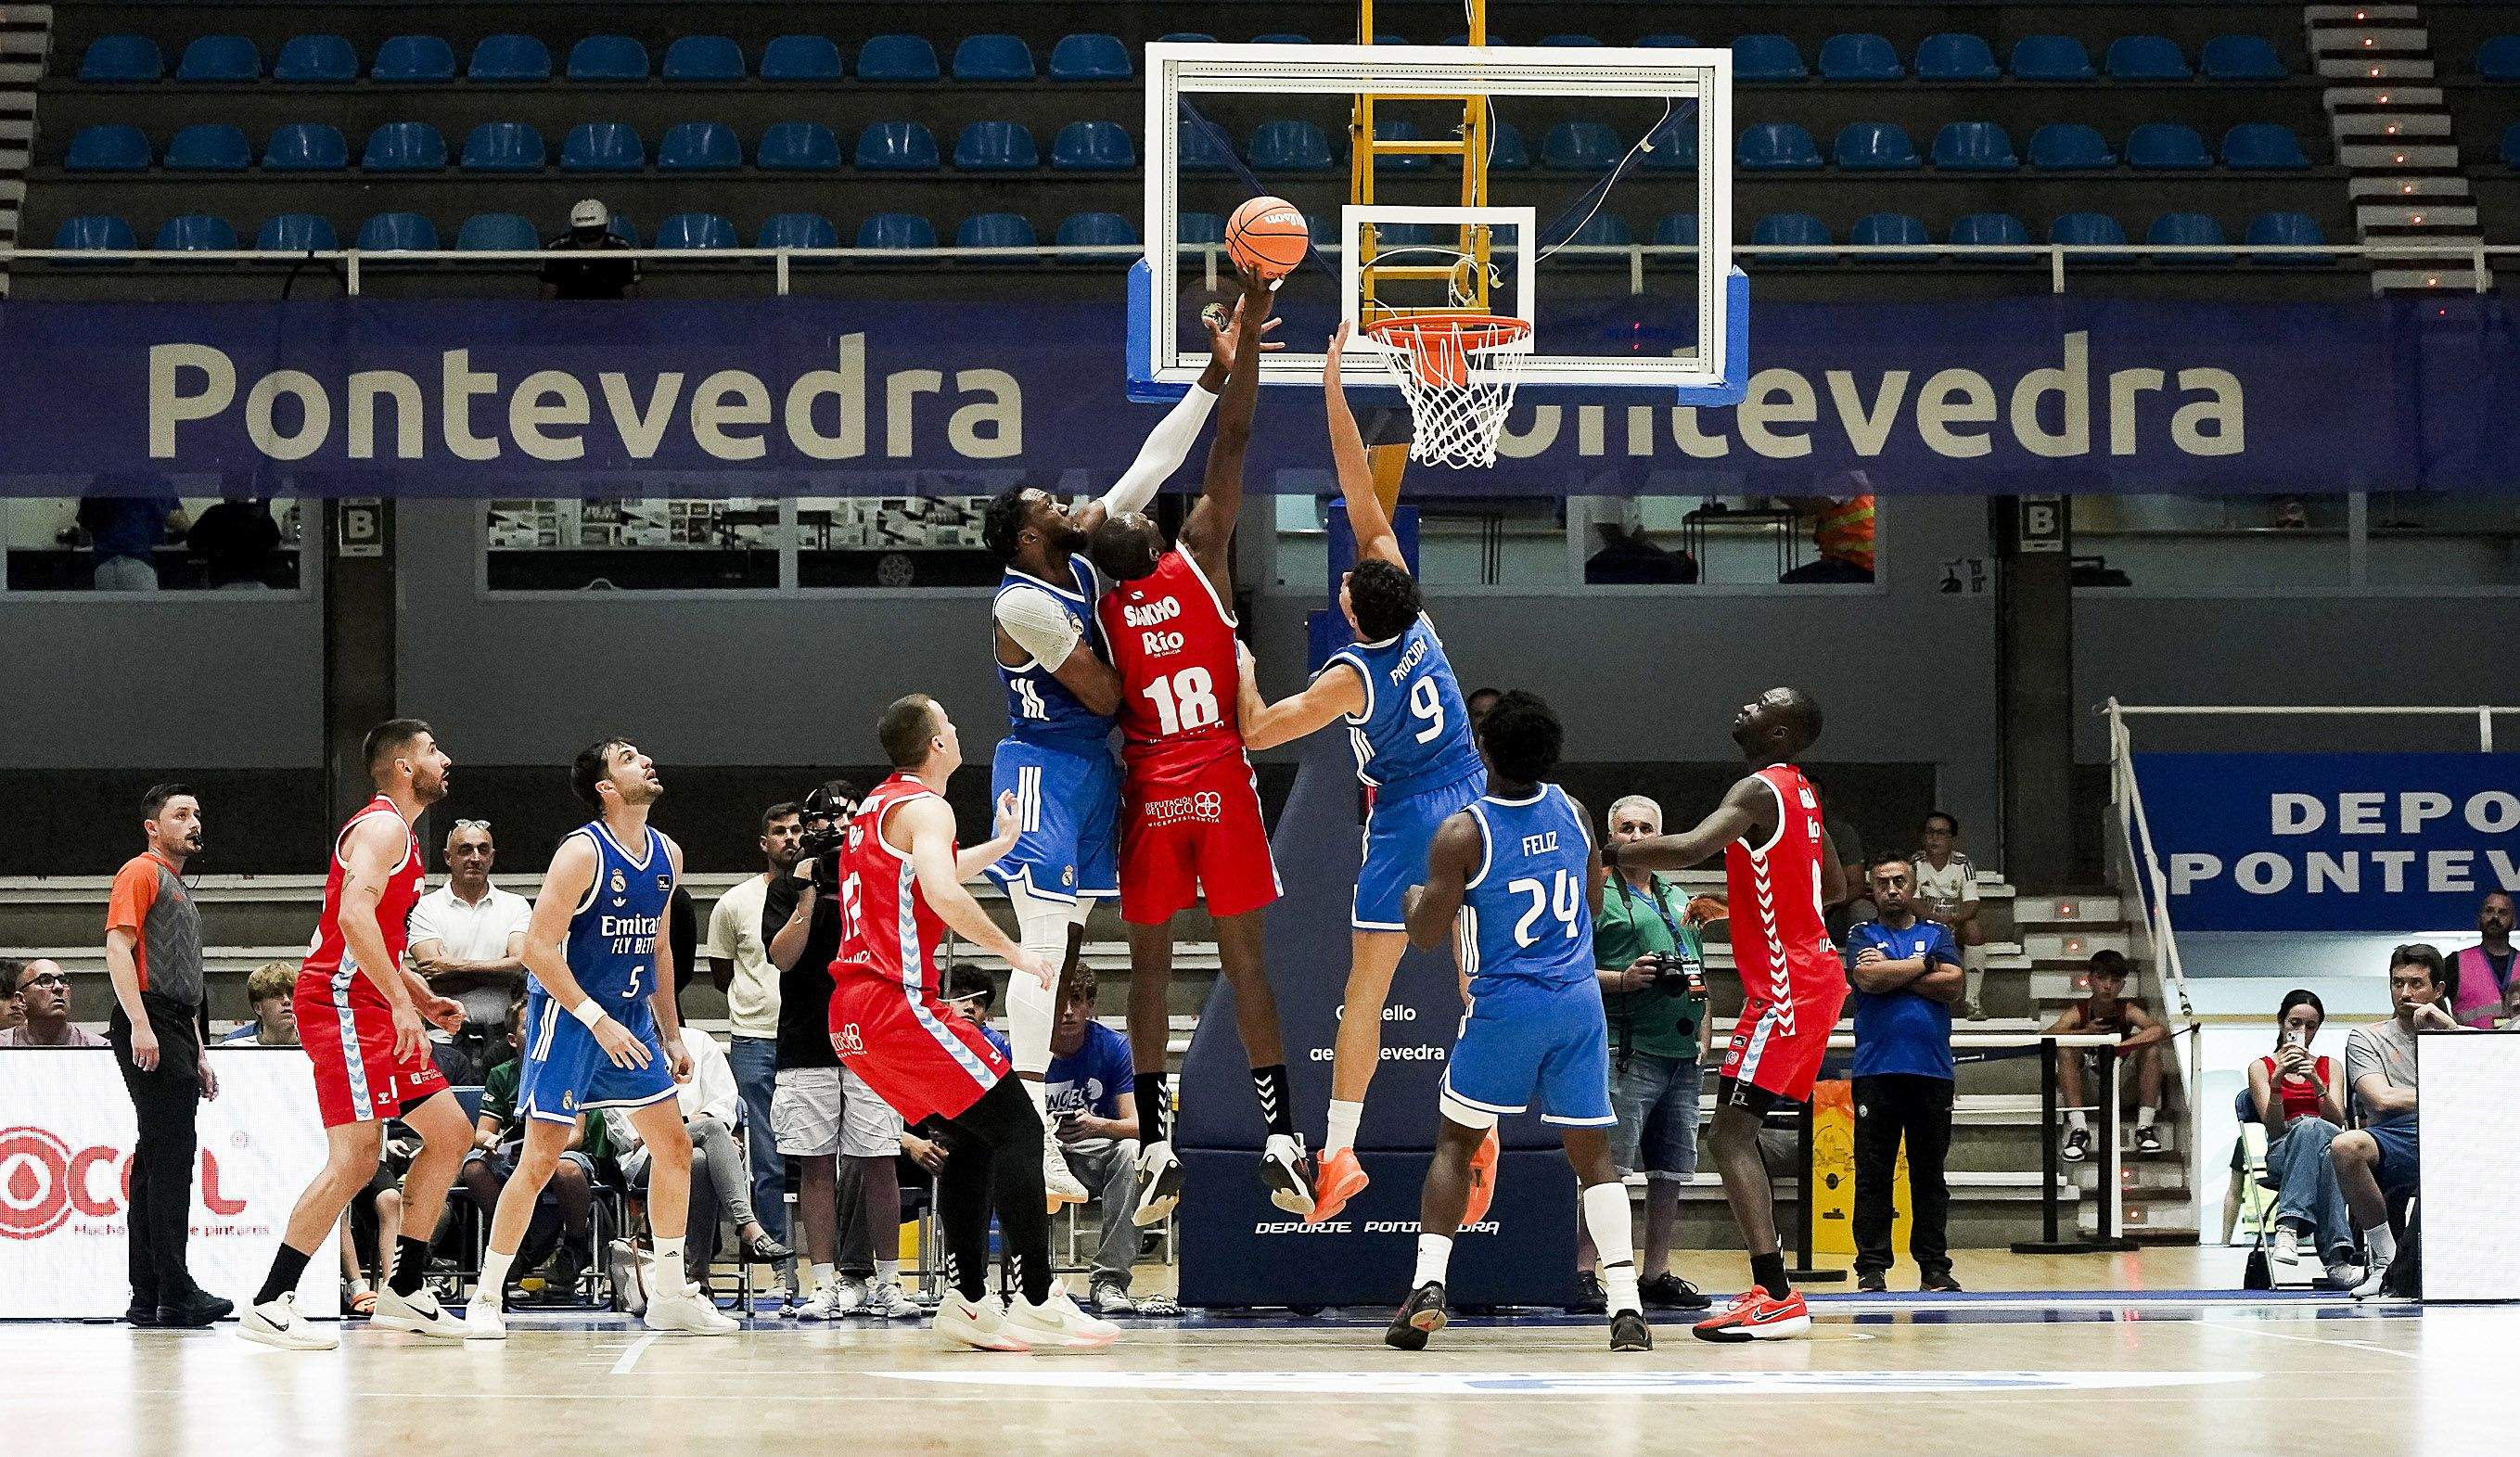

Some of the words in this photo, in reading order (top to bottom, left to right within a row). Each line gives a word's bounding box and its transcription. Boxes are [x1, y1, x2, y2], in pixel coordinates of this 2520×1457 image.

[149, 331, 1023, 461] Pontevedra
[1481, 331, 2245, 459] ontevedra
[349, 509, 375, 538] B
[2028, 505, 2054, 534] B
[1123, 595, 1181, 628] SAKHO
[1142, 631, 1184, 655] Río
[1389, 633, 1429, 687] PROCIDA
[1143, 666, 1220, 736] 18
[1410, 675, 1444, 744] 9
[1157, 802, 1194, 819] LUGO
[2271, 790, 2520, 835] DEPO
[1521, 830, 1559, 857] FELIZ
[1508, 868, 1579, 949] 24
[611, 937, 633, 954] FLY
[621, 965, 645, 998] 5
[1336, 1004, 1416, 1021] Cello
[1255, 1221, 1352, 1233] DEPORTE
[1363, 1221, 1500, 1235] PONTDRA
